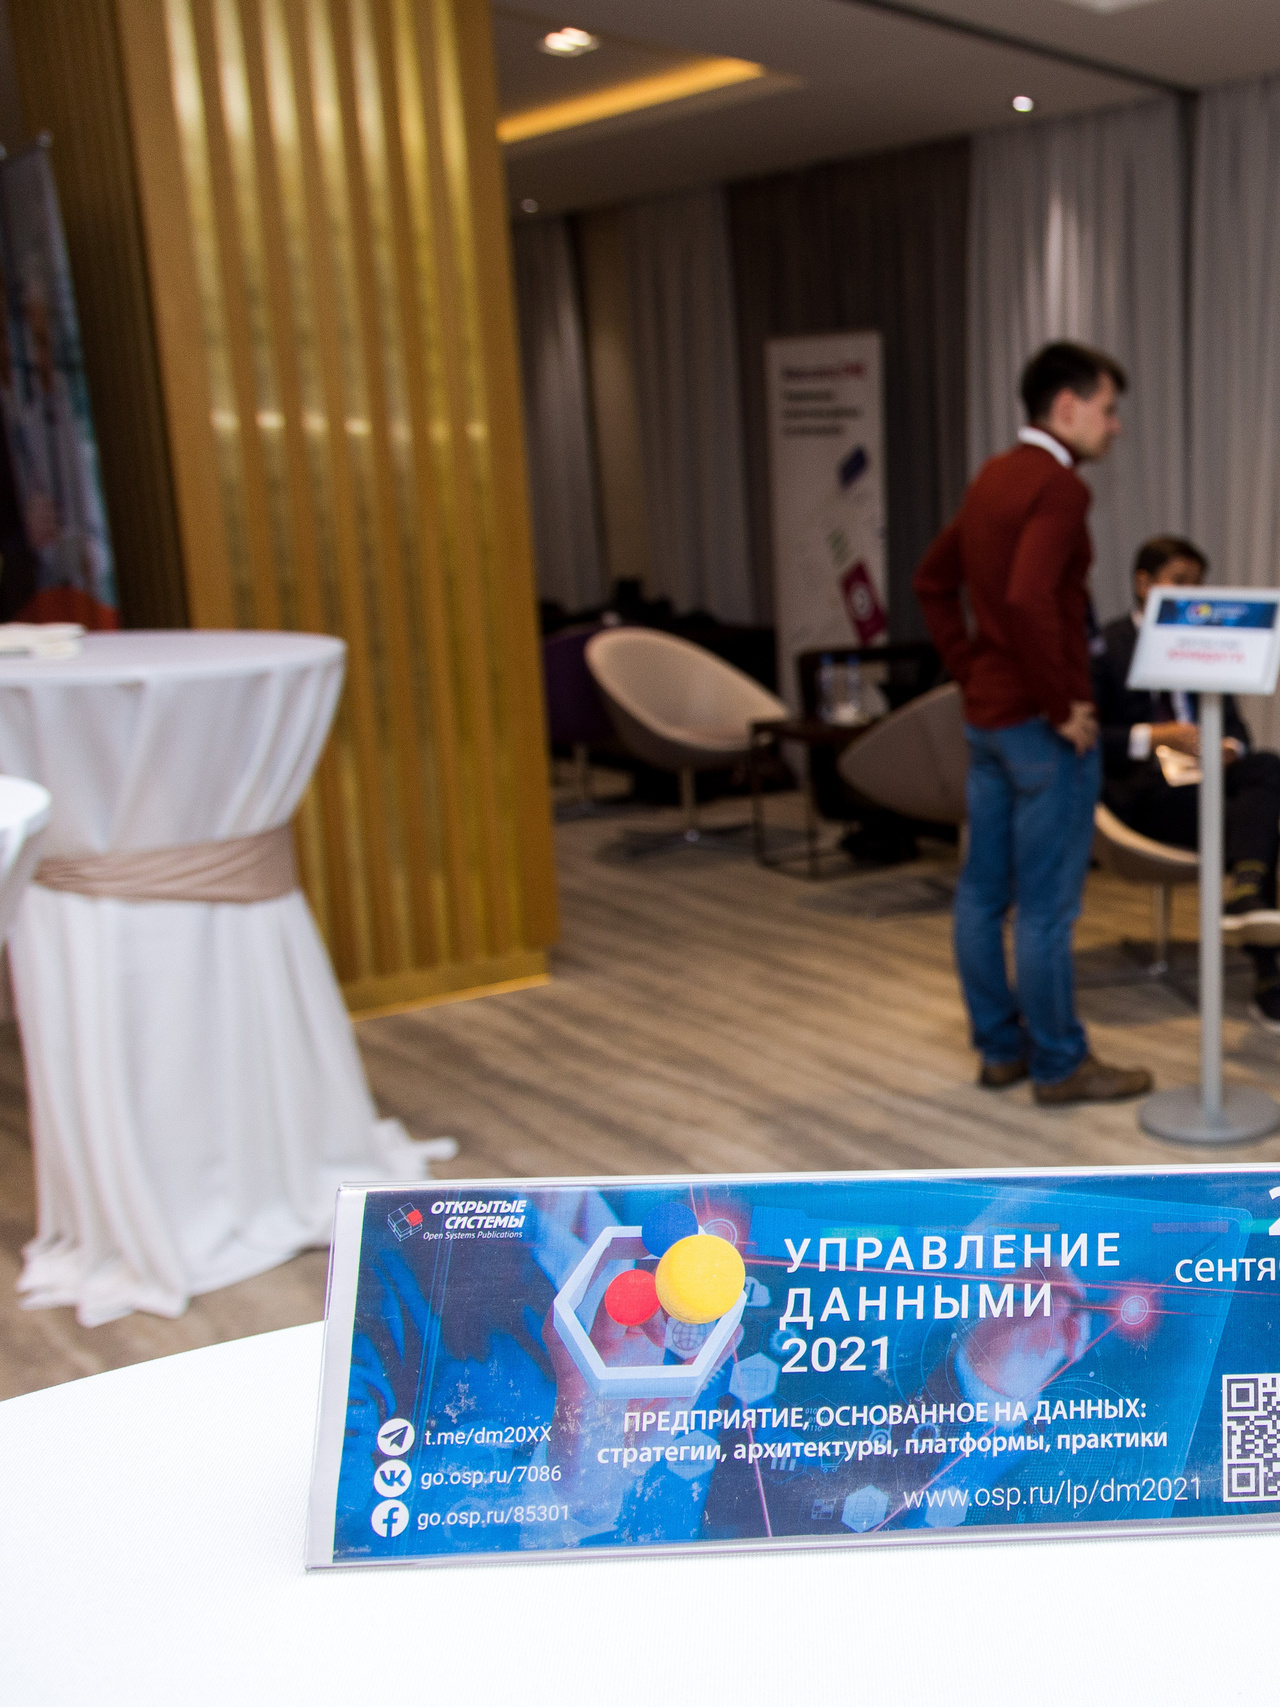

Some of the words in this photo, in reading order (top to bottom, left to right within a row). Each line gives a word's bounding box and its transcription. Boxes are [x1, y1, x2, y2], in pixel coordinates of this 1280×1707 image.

[430, 1200, 527, 1215] ОТКРЫТЫЕ
[444, 1215, 526, 1230] СИСТЕМЫ
[423, 1231, 443, 1241] Open
[445, 1231, 476, 1241] Systems
[477, 1230, 523, 1239] Publications
[784, 1232, 1121, 1273] УПРАВЛЕНИЕ
[779, 1283, 1051, 1331] ДАННЫМИ
[781, 1336, 889, 1373] 2021
[623, 1407, 809, 1435] ПРЕДПРИЯТИЕ,
[816, 1401, 988, 1427] ОСНОВАННОЕ
[994, 1401, 1029, 1422] НА
[1033, 1398, 1147, 1424] ДАННЫХ:
[424, 1425, 552, 1446] t.me/dm20XX
[597, 1444, 727, 1468] стратегии,
[733, 1438, 898, 1463] архитектуры,
[905, 1432, 1050, 1457] платформы,
[1057, 1431, 1168, 1454] практики
[421, 1465, 562, 1489] go.osp.ru/7086
[903, 1476, 1200, 1511] www.osp.ru/lp/dm2021
[417, 1505, 569, 1530] go.osp.ru/85301
